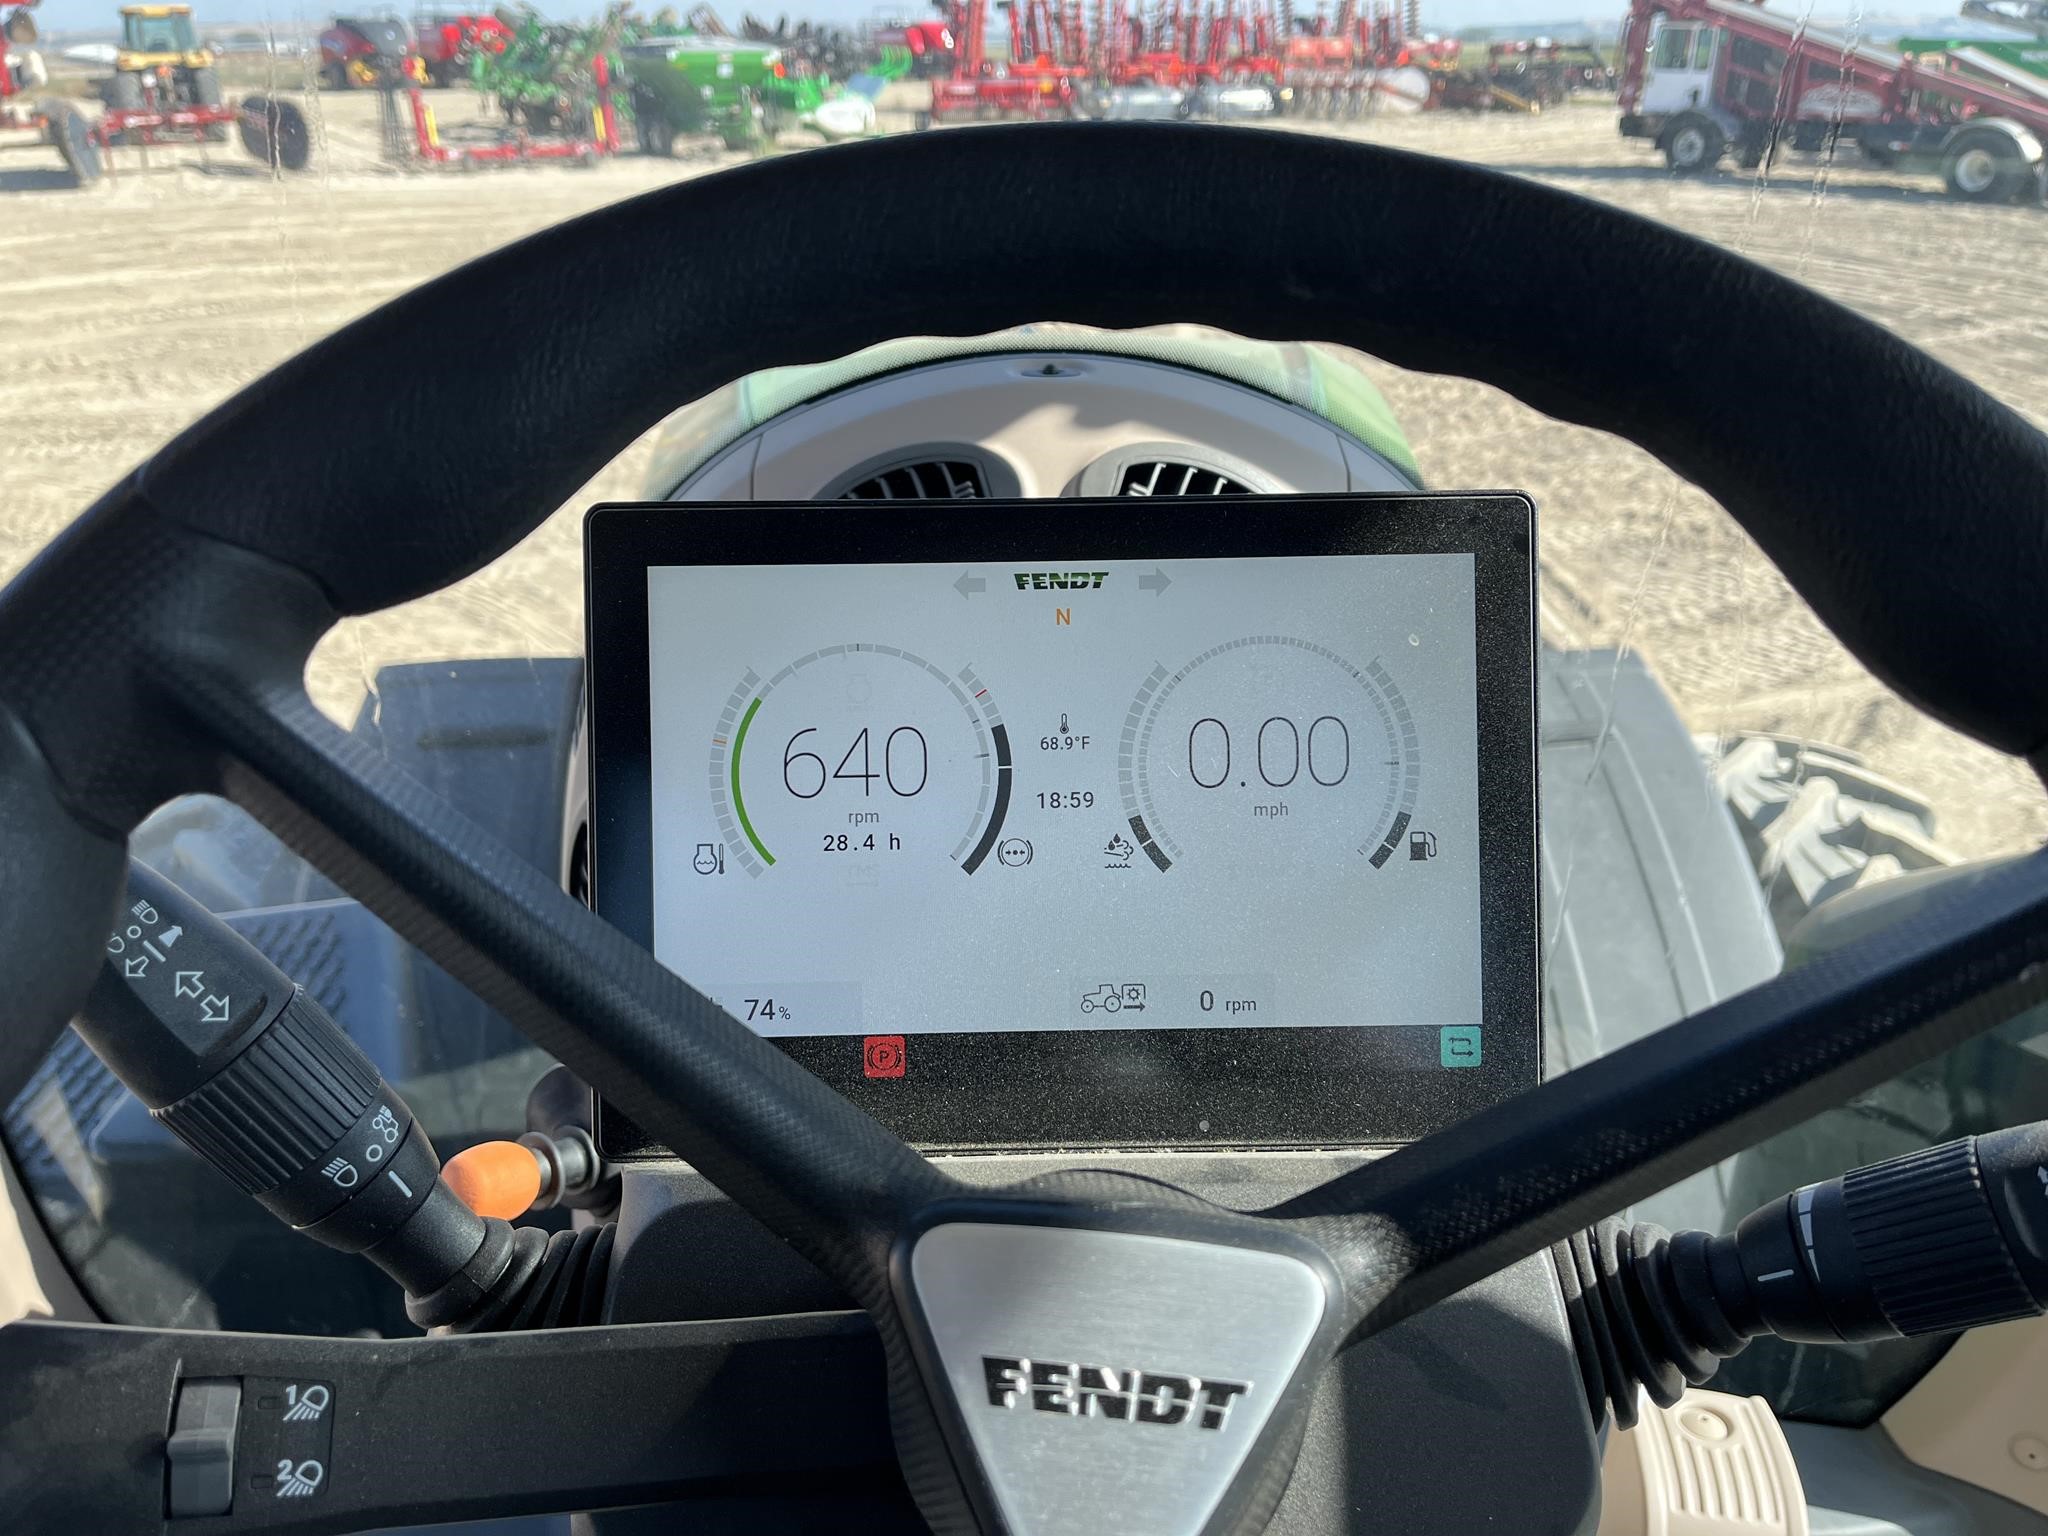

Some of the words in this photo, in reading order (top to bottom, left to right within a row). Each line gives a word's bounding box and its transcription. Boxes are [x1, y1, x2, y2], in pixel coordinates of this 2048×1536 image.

[1013, 572, 1109, 590] FENDT
[1055, 608, 1071, 625] N
[1040, 735, 1090, 751] 68.9°F
[1188, 715, 1350, 789] 0.00
[783, 726, 928, 799] 640
[1036, 791, 1095, 810] 18:59
[848, 811, 880, 827] rpm
[1253, 802, 1289, 819] mph
[823, 834, 875, 852] 28.4
[889, 833, 901, 850] h
[1200, 990, 1214, 1011] 0
[1226, 1000, 1257, 1015] rpm
[285, 1384, 297, 1405] 1
[981, 1355, 1254, 1430] FENDT
[277, 1459, 293, 1481] 2
